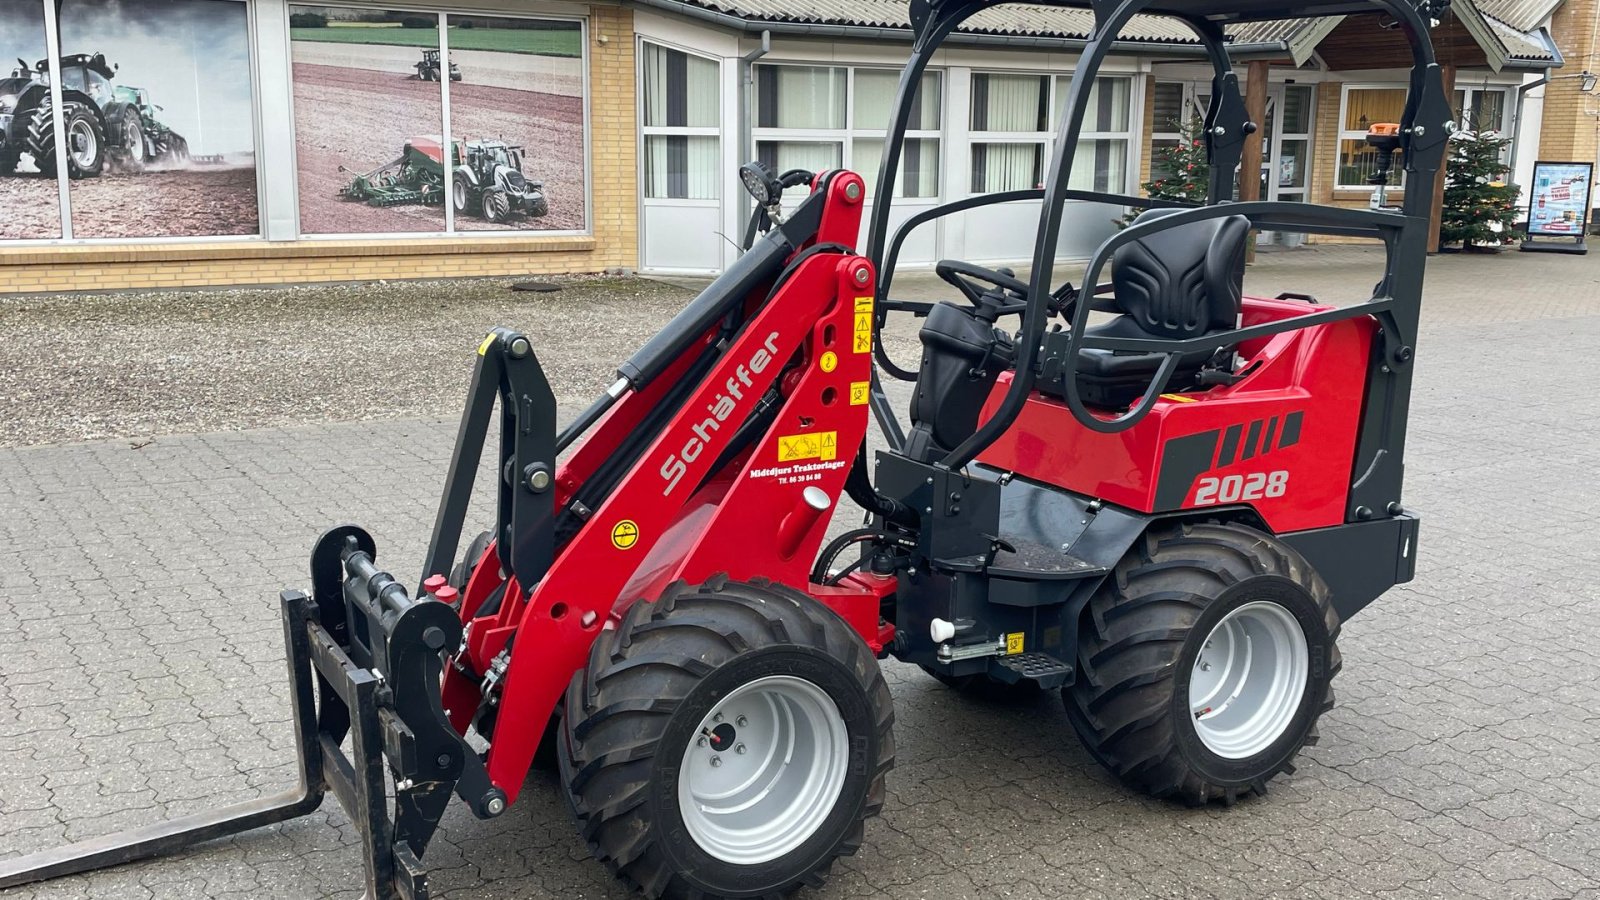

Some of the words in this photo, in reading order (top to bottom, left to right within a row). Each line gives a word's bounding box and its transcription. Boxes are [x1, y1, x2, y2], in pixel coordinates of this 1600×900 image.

[660, 331, 779, 496] Schäffer
[750, 466, 792, 478] Midtdjurs
[793, 461, 845, 473] Traktorlager
[1194, 470, 1289, 506] 2028
